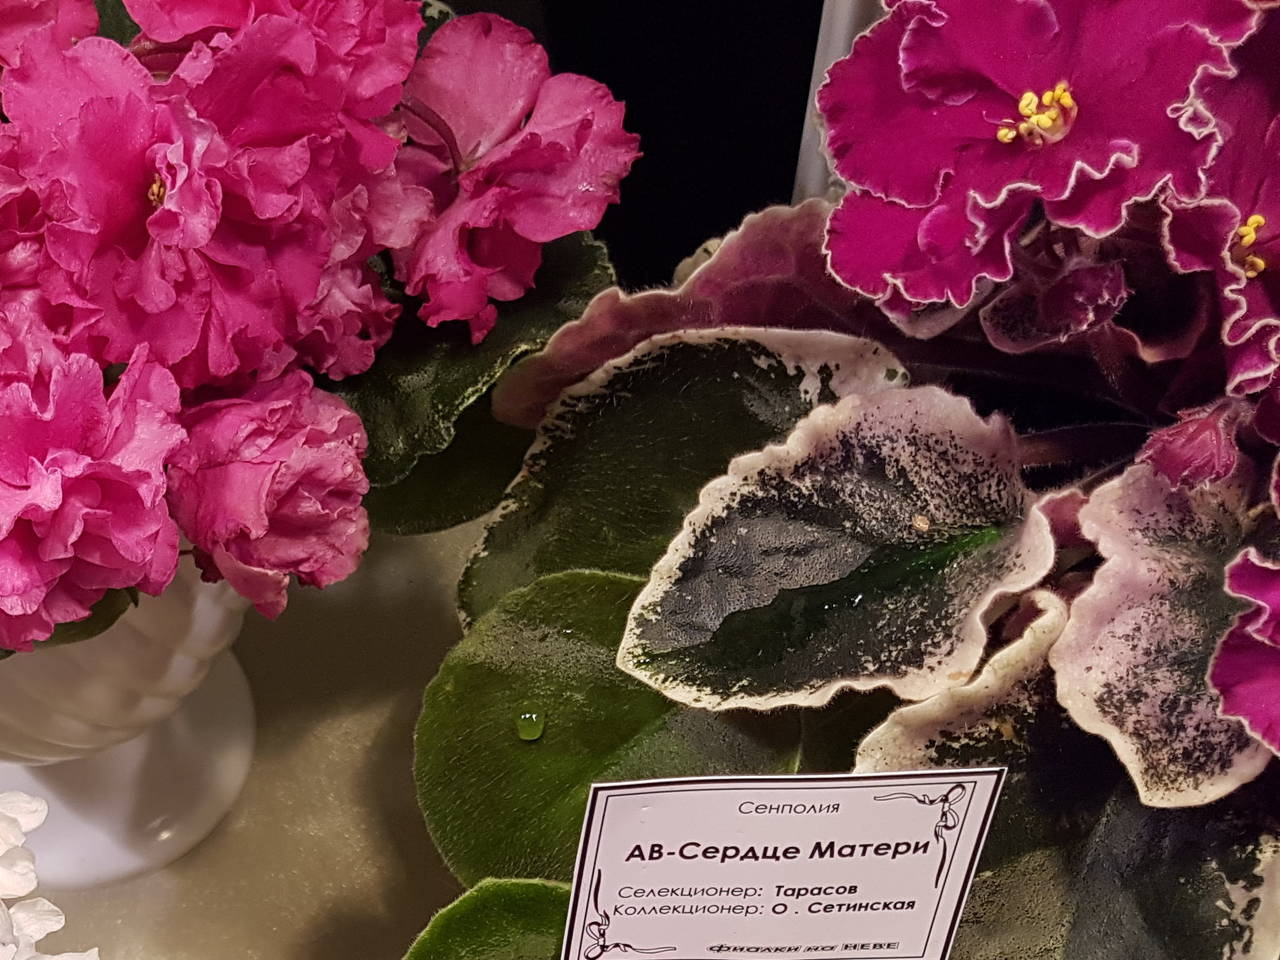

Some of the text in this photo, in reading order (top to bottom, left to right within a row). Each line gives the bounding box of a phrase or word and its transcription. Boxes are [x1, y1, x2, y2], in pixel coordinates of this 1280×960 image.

[738, 801, 841, 815] Сенполия
[624, 840, 931, 864] АВ-Сердце Матери
[618, 884, 859, 900] Селекционер: Тарасов
[613, 903, 765, 918] Коллекционер:
[807, 900, 917, 915] Сетинская
